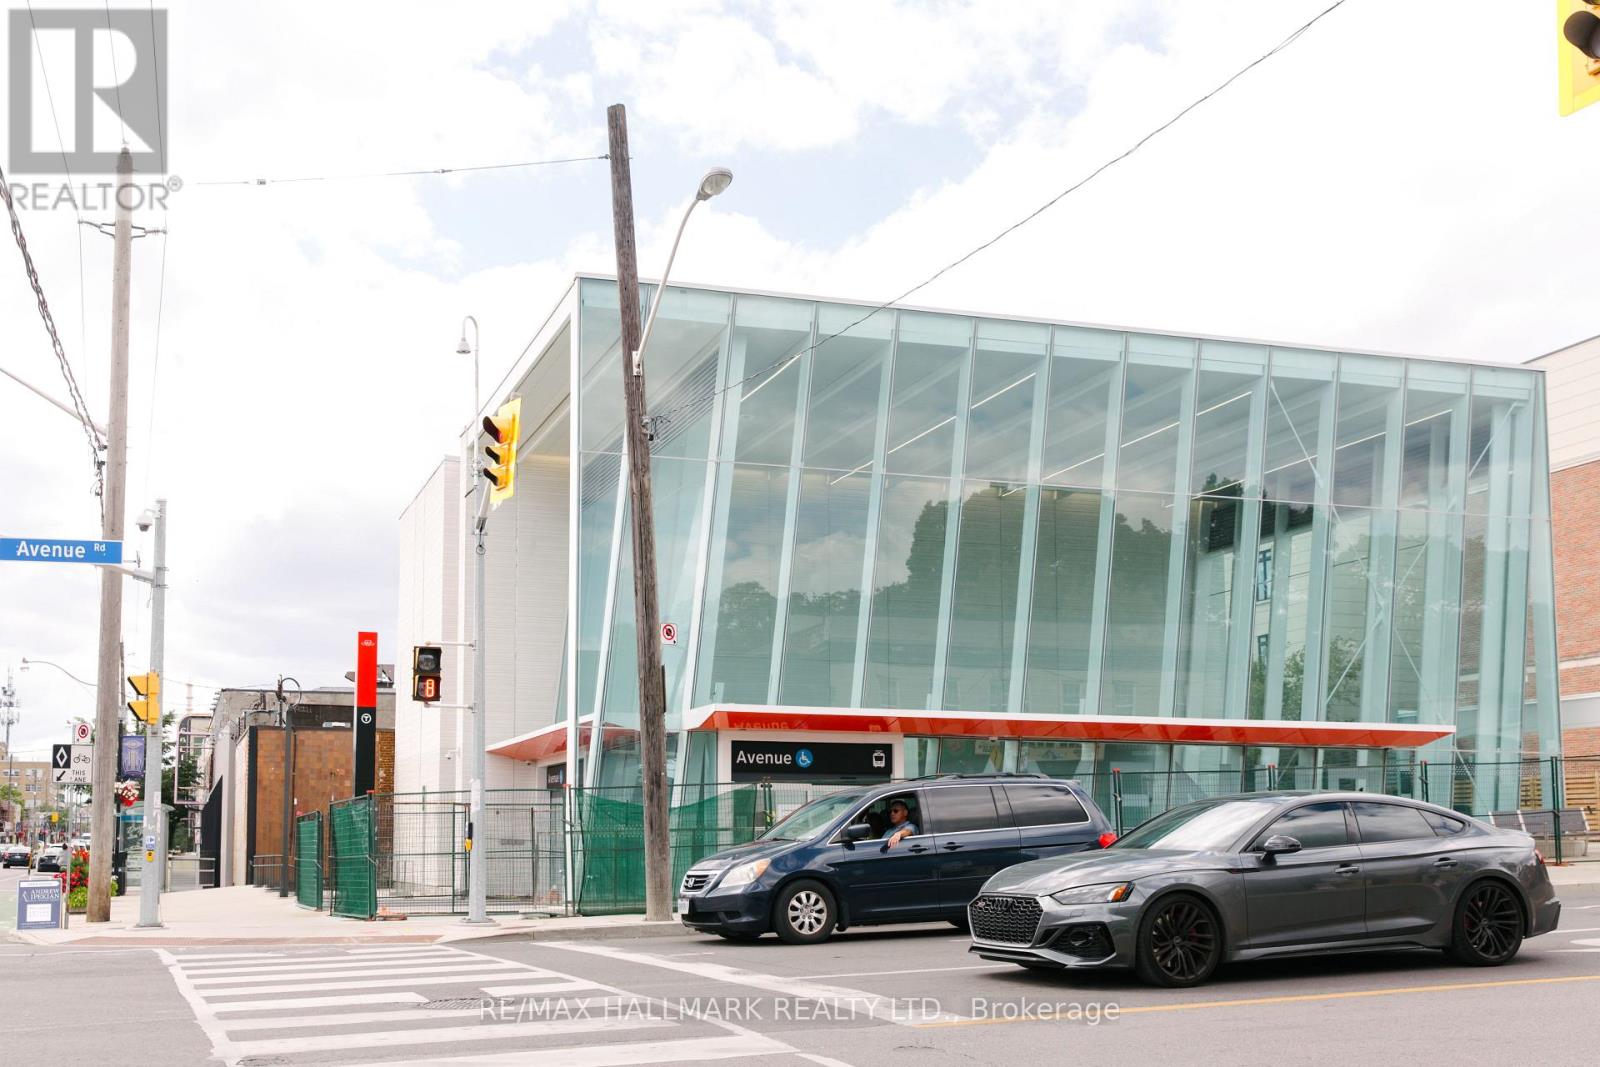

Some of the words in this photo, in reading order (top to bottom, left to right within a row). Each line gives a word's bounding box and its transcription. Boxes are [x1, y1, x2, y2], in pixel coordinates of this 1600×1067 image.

[16, 540, 86, 558] Avenue
[93, 543, 106, 552] Rd
[736, 750, 792, 765] Avenue
